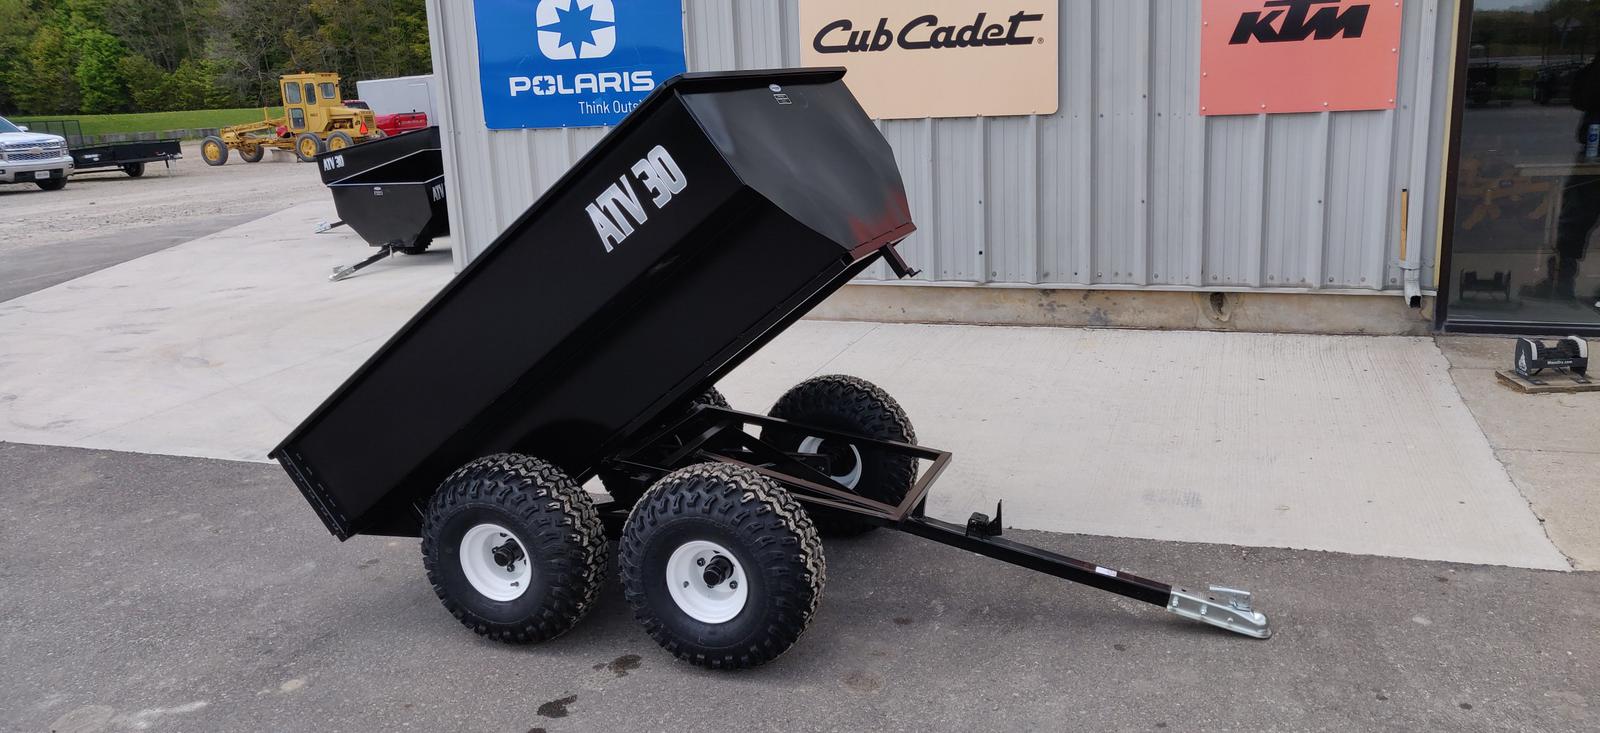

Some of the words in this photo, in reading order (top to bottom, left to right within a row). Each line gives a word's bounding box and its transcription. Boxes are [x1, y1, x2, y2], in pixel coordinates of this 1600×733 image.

[813, 18, 893, 54] Cub
[897, 11, 1044, 49] Cadet
[1228, 0, 1370, 45] KTM
[509, 71, 655, 97] POLARIS
[578, 101, 611, 115] Think
[323, 157, 335, 171] ATV
[335, 155, 345, 168] 30
[432, 184, 445, 202] ATV
[585, 174, 648, 253] ATV
[631, 144, 688, 209] 30
